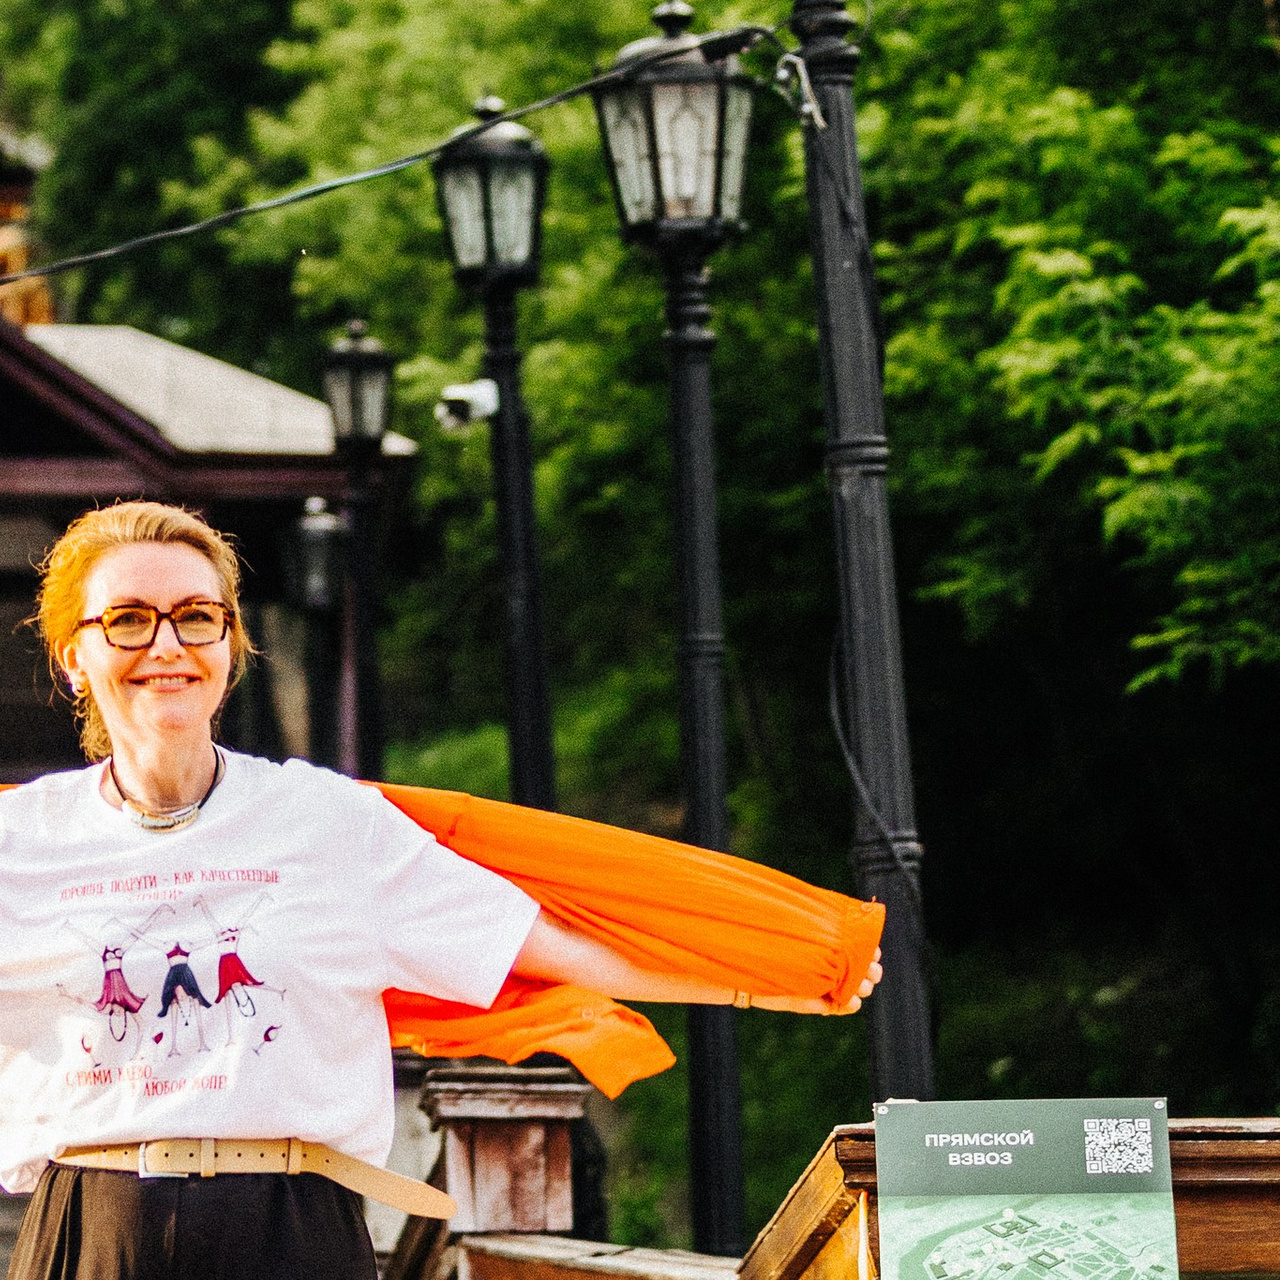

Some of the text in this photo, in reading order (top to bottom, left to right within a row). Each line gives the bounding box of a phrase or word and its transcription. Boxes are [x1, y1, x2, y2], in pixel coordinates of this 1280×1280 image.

[173, 870, 195, 885] КАК
[924, 1129, 1035, 1147] ПРЯМСКОЙ
[948, 1151, 1013, 1166] ВЗВОЗ
